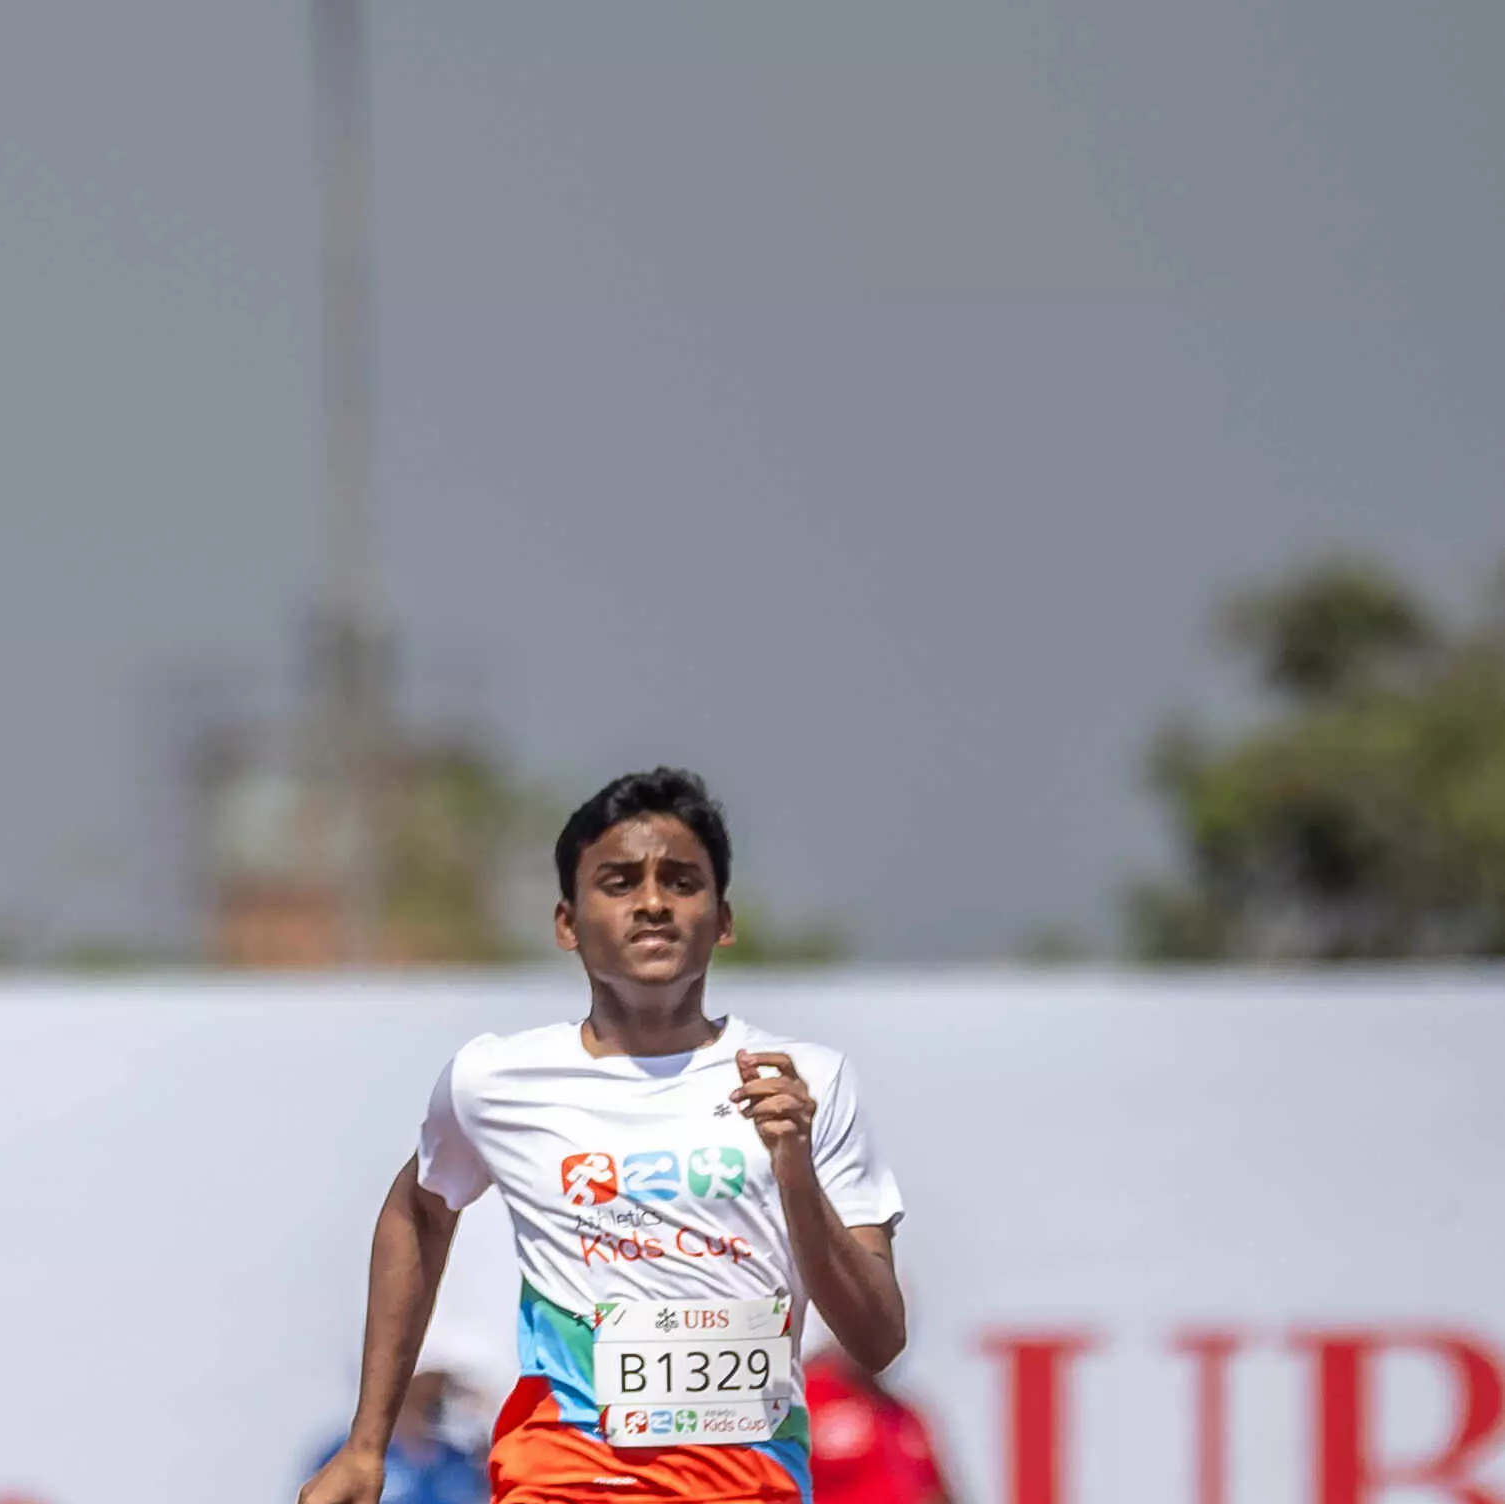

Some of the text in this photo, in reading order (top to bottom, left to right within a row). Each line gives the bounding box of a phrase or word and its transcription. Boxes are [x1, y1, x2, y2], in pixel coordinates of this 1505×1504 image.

[580, 1230, 665, 1267] Kids
[684, 1309, 729, 1328] UBS
[620, 1349, 770, 1394] B1329
